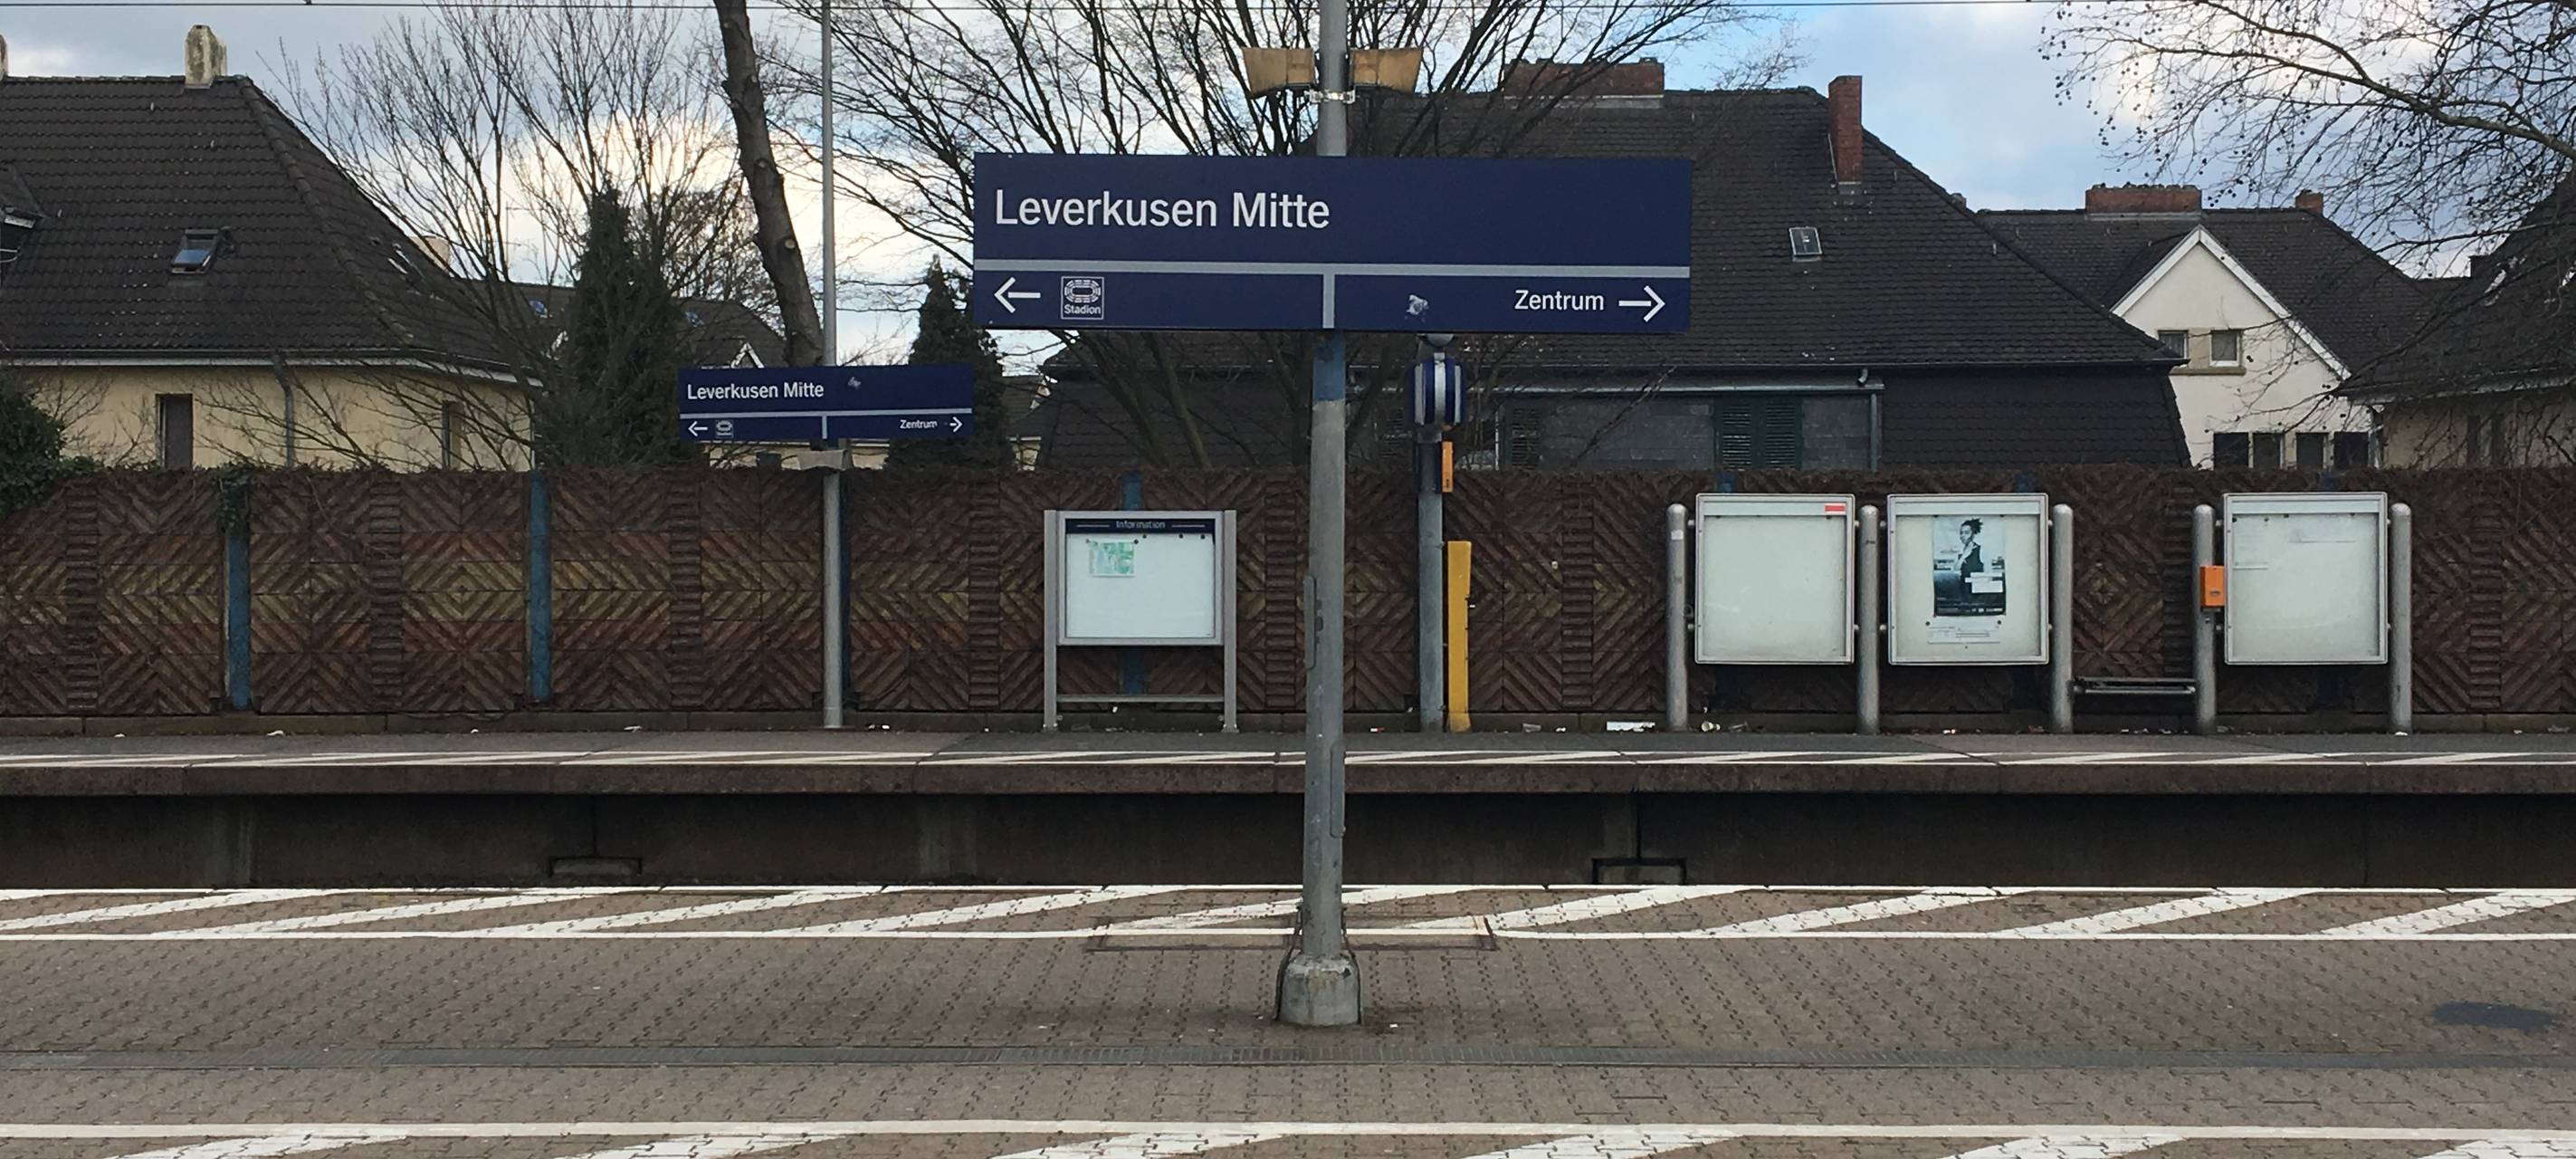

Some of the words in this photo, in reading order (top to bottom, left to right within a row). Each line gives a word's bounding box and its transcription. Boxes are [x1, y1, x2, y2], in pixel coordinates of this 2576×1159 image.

[996, 188, 1217, 227] Leverkusen
[1233, 192, 1330, 229] Mitte
[1514, 289, 1604, 311] Zentrum
[1064, 303, 1102, 315] Stadion
[687, 383, 778, 400] Leverkusen
[783, 381, 825, 398] Mitte
[900, 419, 938, 429] Zentrum
[1116, 521, 1166, 529] Information
